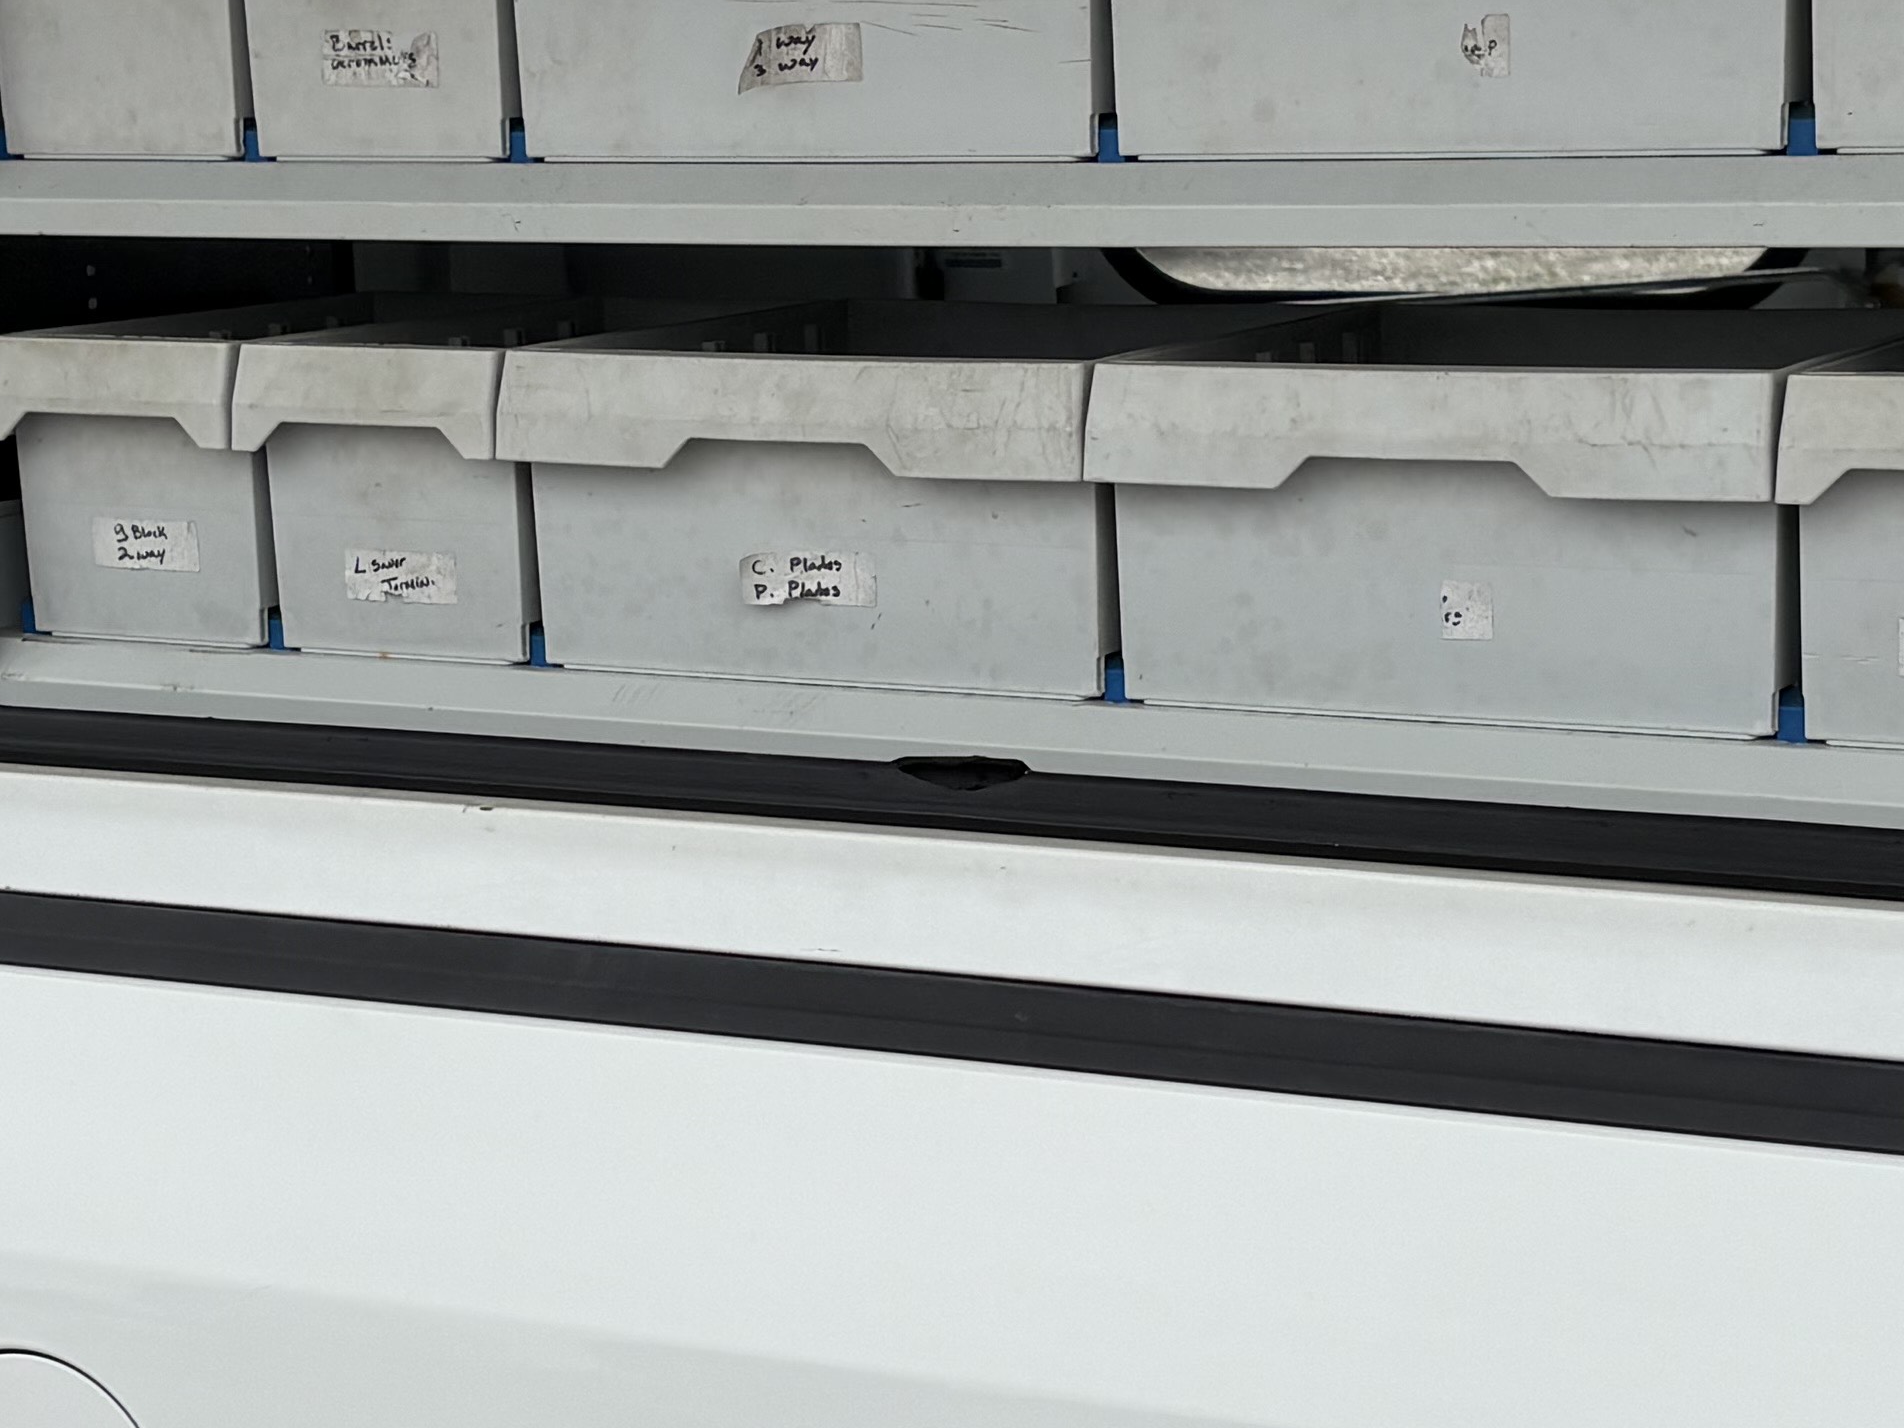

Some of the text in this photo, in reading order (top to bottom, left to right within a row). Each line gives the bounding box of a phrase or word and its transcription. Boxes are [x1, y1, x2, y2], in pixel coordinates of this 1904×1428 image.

[776, 34, 816, 56] way
[778, 56, 819, 72] way
[131, 524, 168, 541] Block
[117, 546, 166, 566] 2 way
